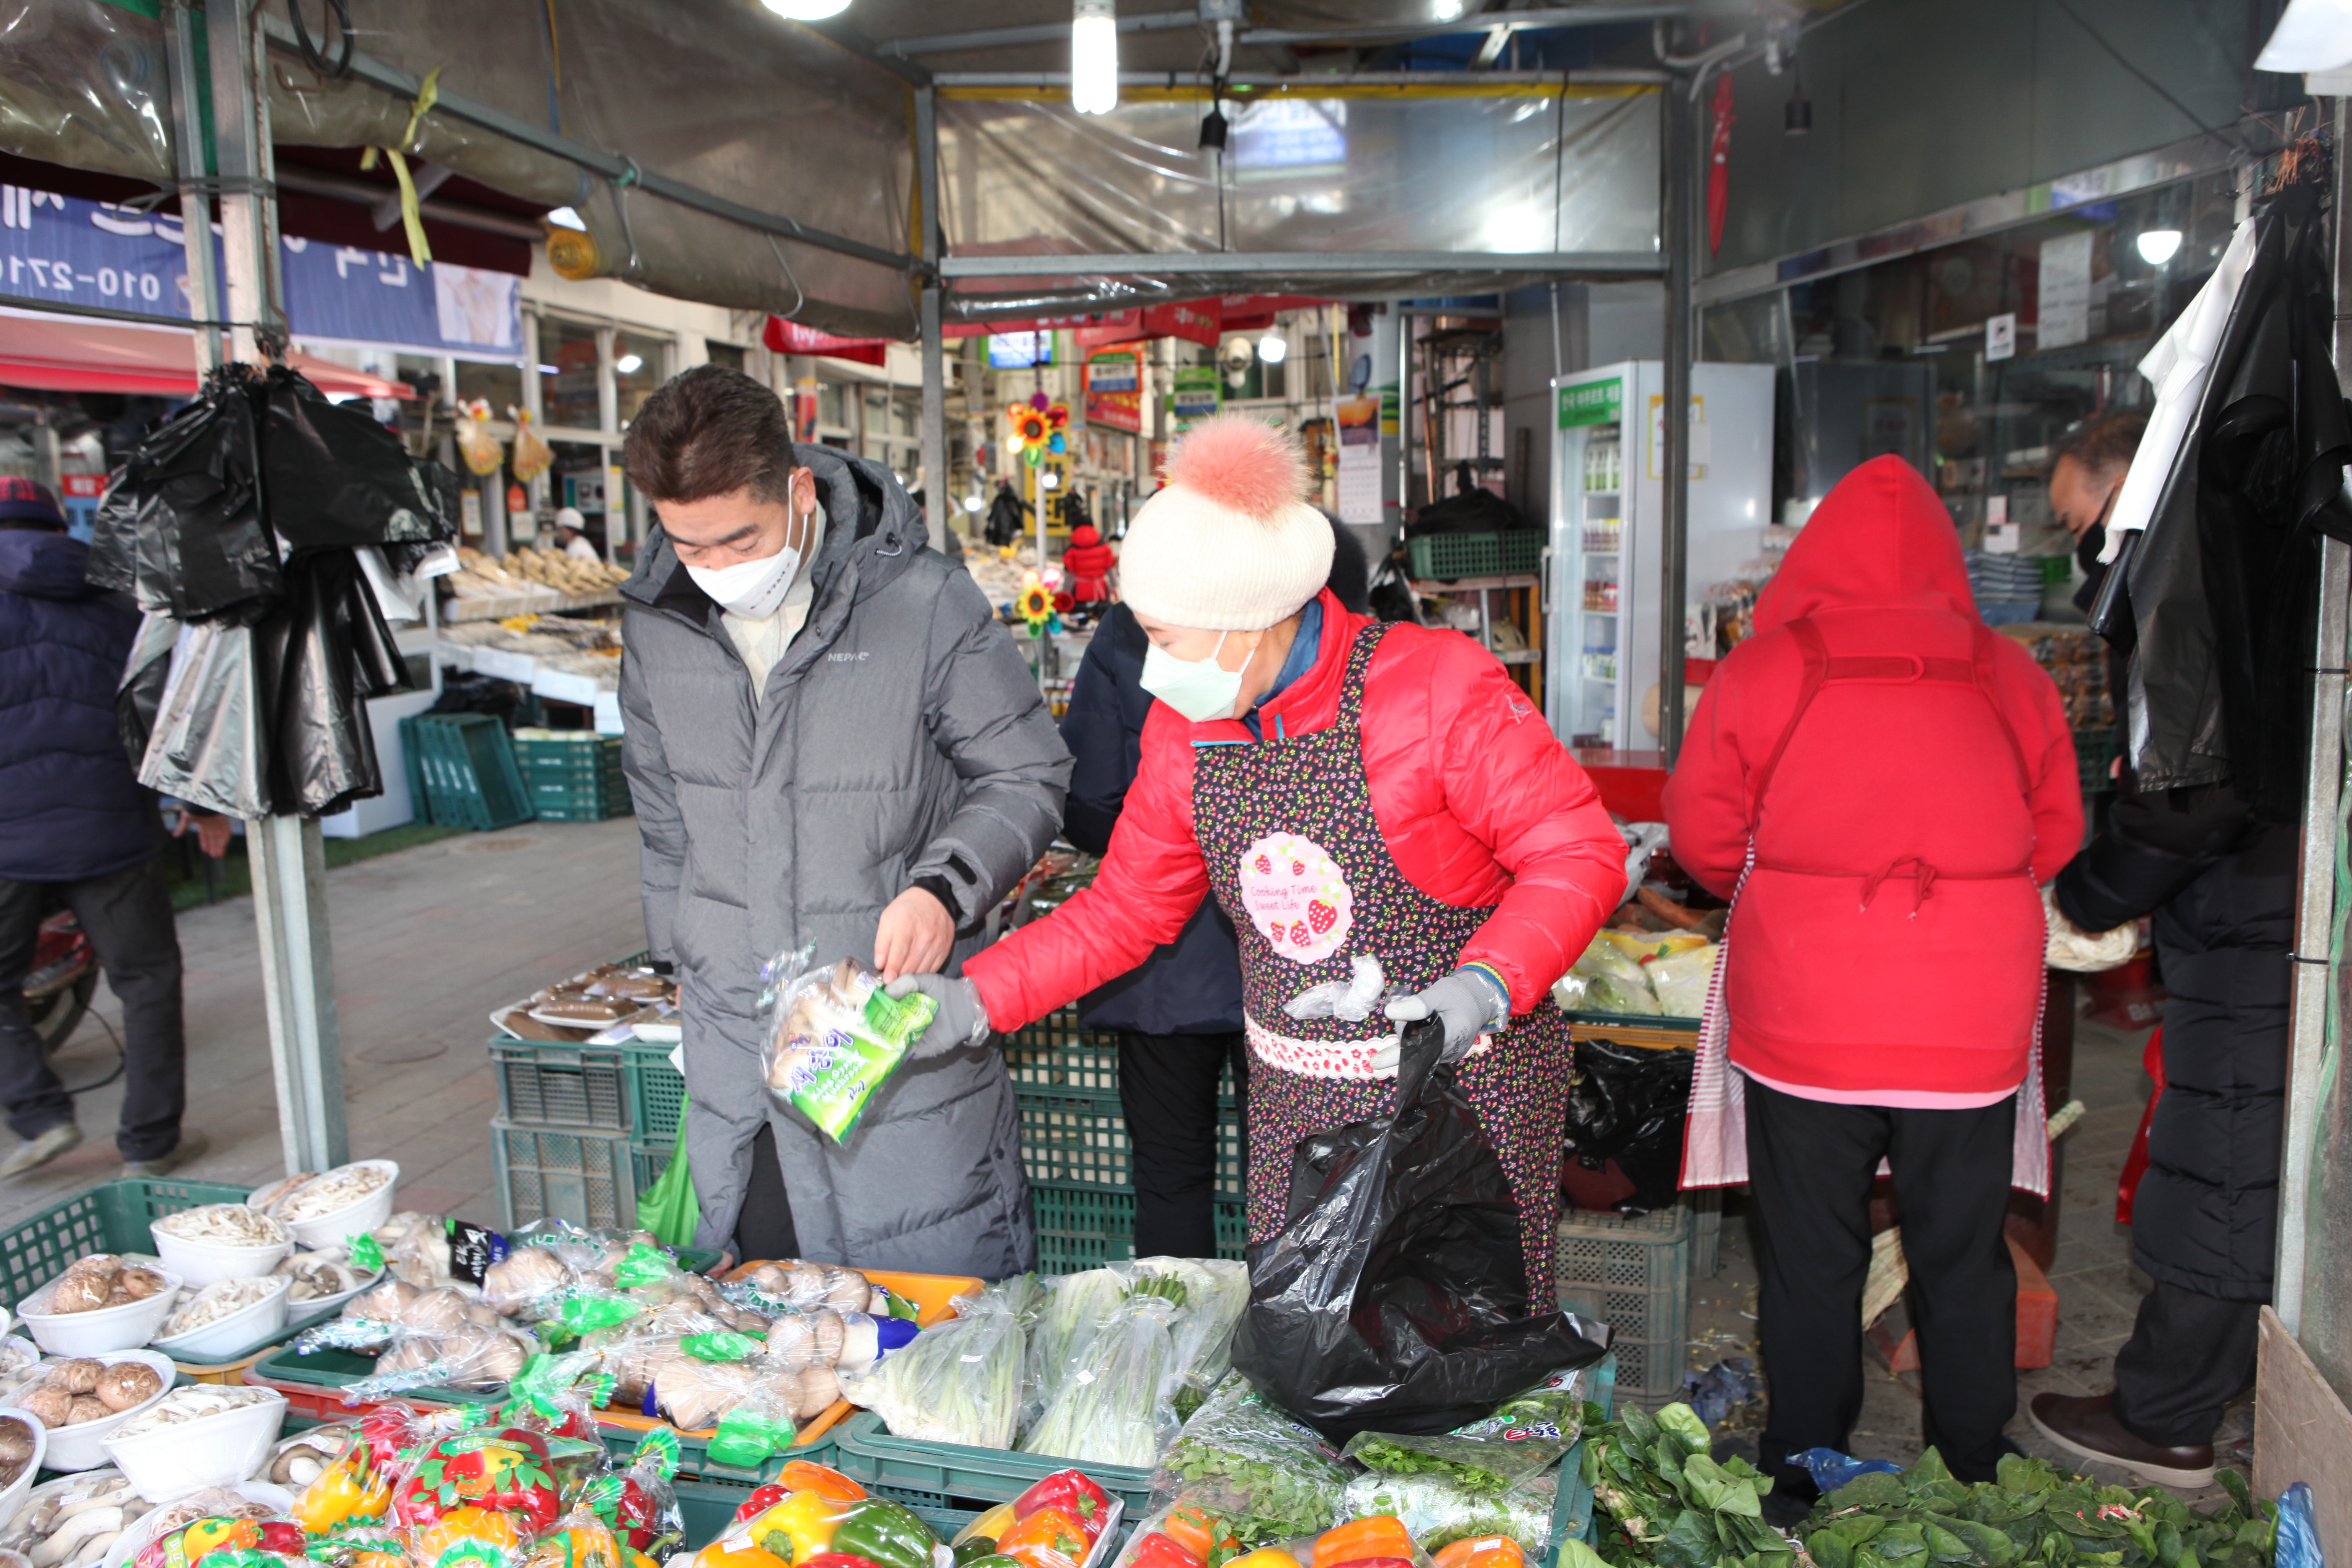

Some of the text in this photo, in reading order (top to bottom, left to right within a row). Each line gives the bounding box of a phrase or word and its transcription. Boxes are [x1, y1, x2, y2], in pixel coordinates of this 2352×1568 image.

[1251, 885, 1318, 900] Cooking Time
[1255, 898, 1300, 912] Sweet Life
[789, 1027, 854, 1095] 새송이
[810, 1077, 834, 1101] King
[820, 1058, 868, 1103] Mushroom
[452, 1437, 516, 1449] 파프리카
